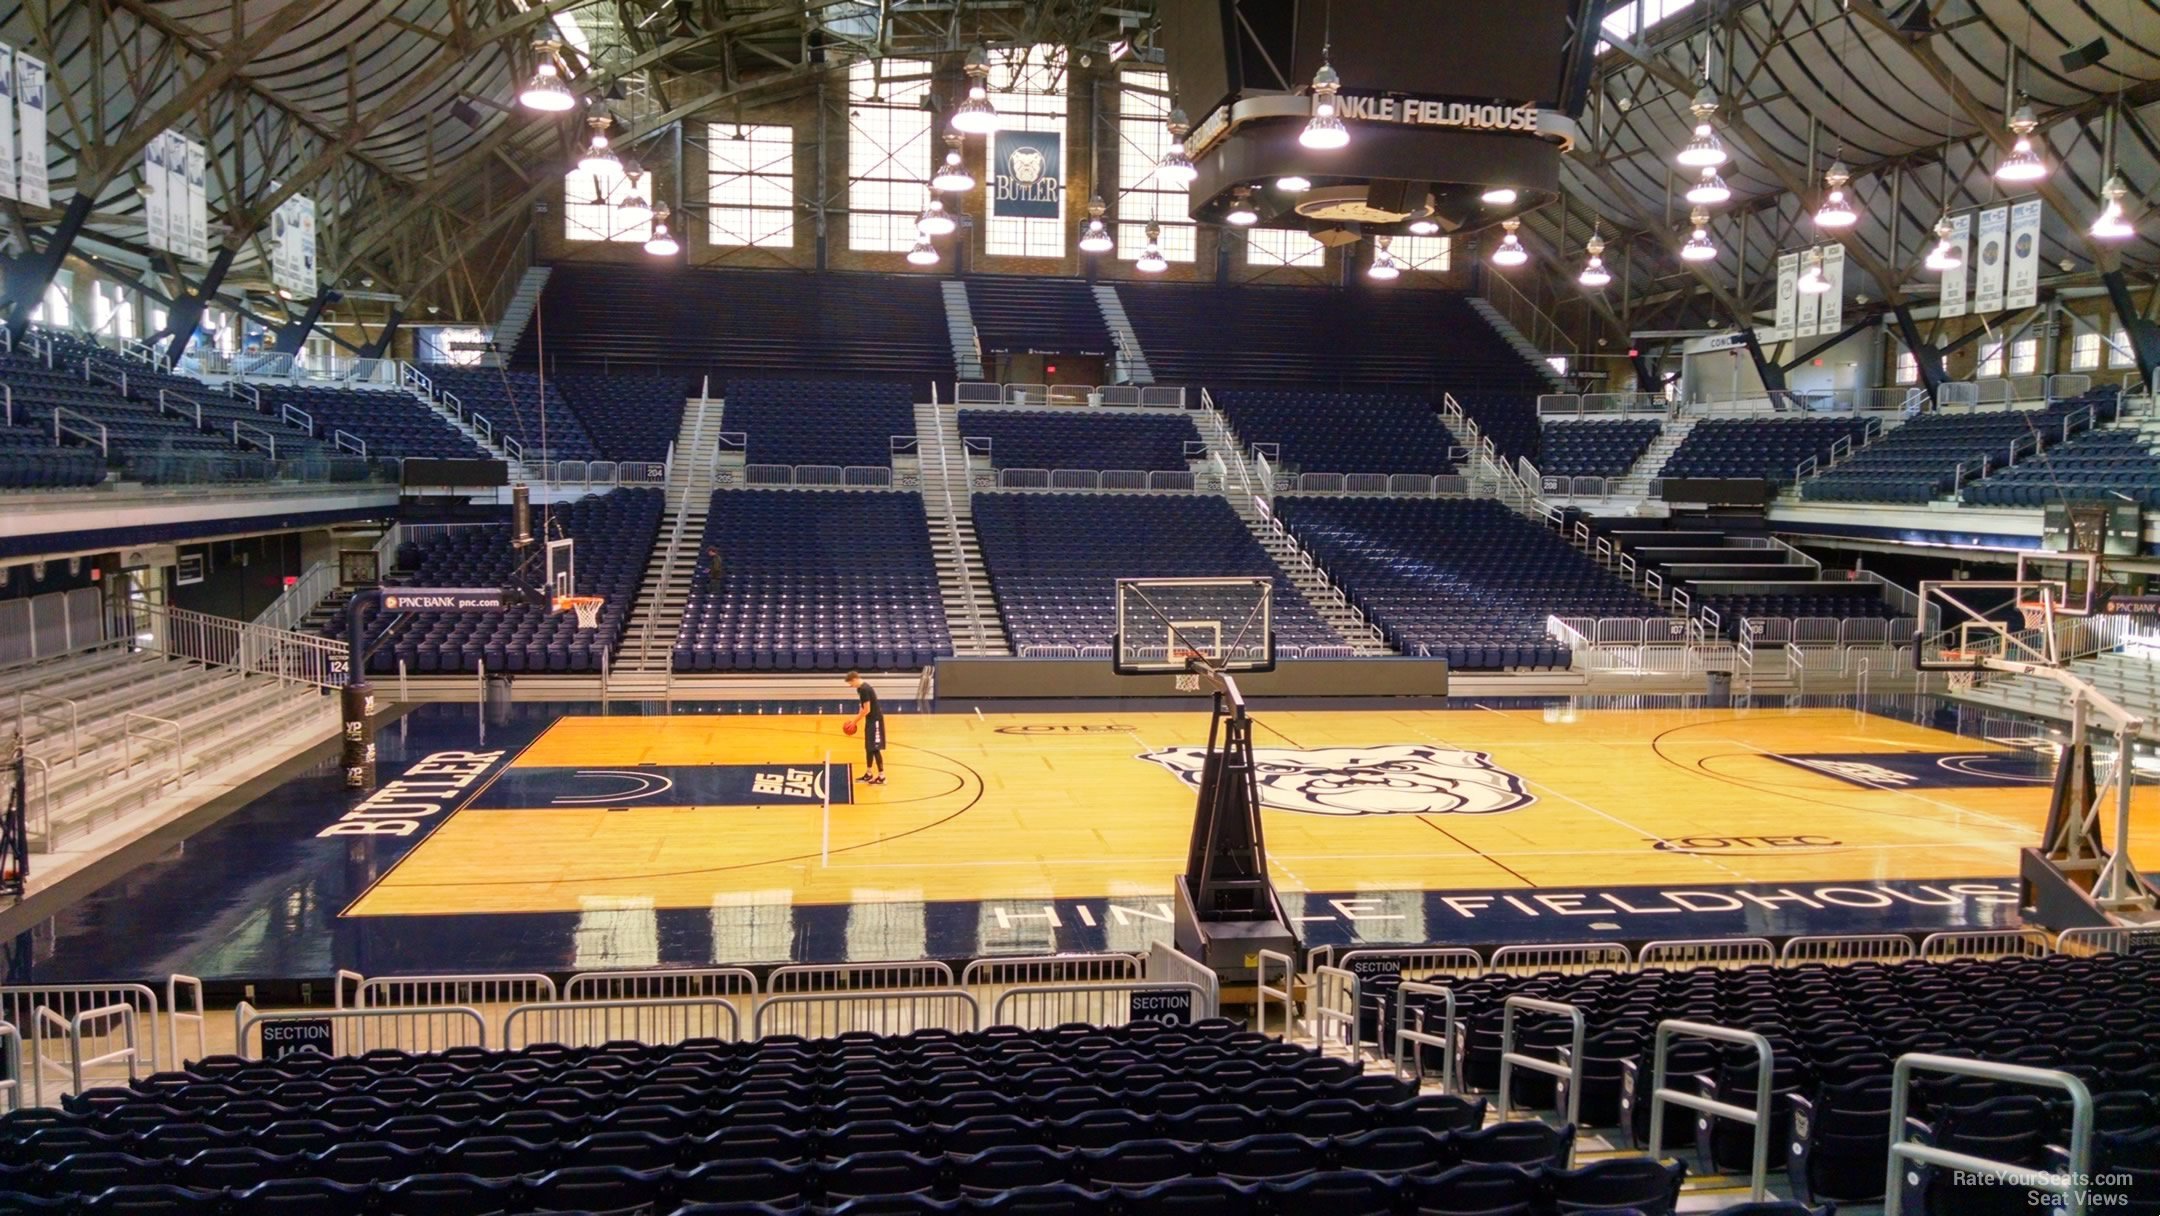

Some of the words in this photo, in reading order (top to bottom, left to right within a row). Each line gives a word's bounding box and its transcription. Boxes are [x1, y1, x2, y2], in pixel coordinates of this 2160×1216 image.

[1402, 99, 1538, 131] FIELDHOUSE
[996, 175, 1057, 202] BUTLER
[459, 599, 500, 609] pnc.com
[1671, 625, 1684, 634] 107
[331, 661, 349, 673] 124
[752, 772, 785, 795] BIG
[784, 767, 814, 798] EAST
[315, 750, 506, 838] BUTLER
[1441, 883, 2020, 918] FIELDHOUS
[1354, 961, 1400, 973] SECTION
[1132, 996, 1190, 1010] SECTION
[263, 1025, 330, 1041] SECTION
